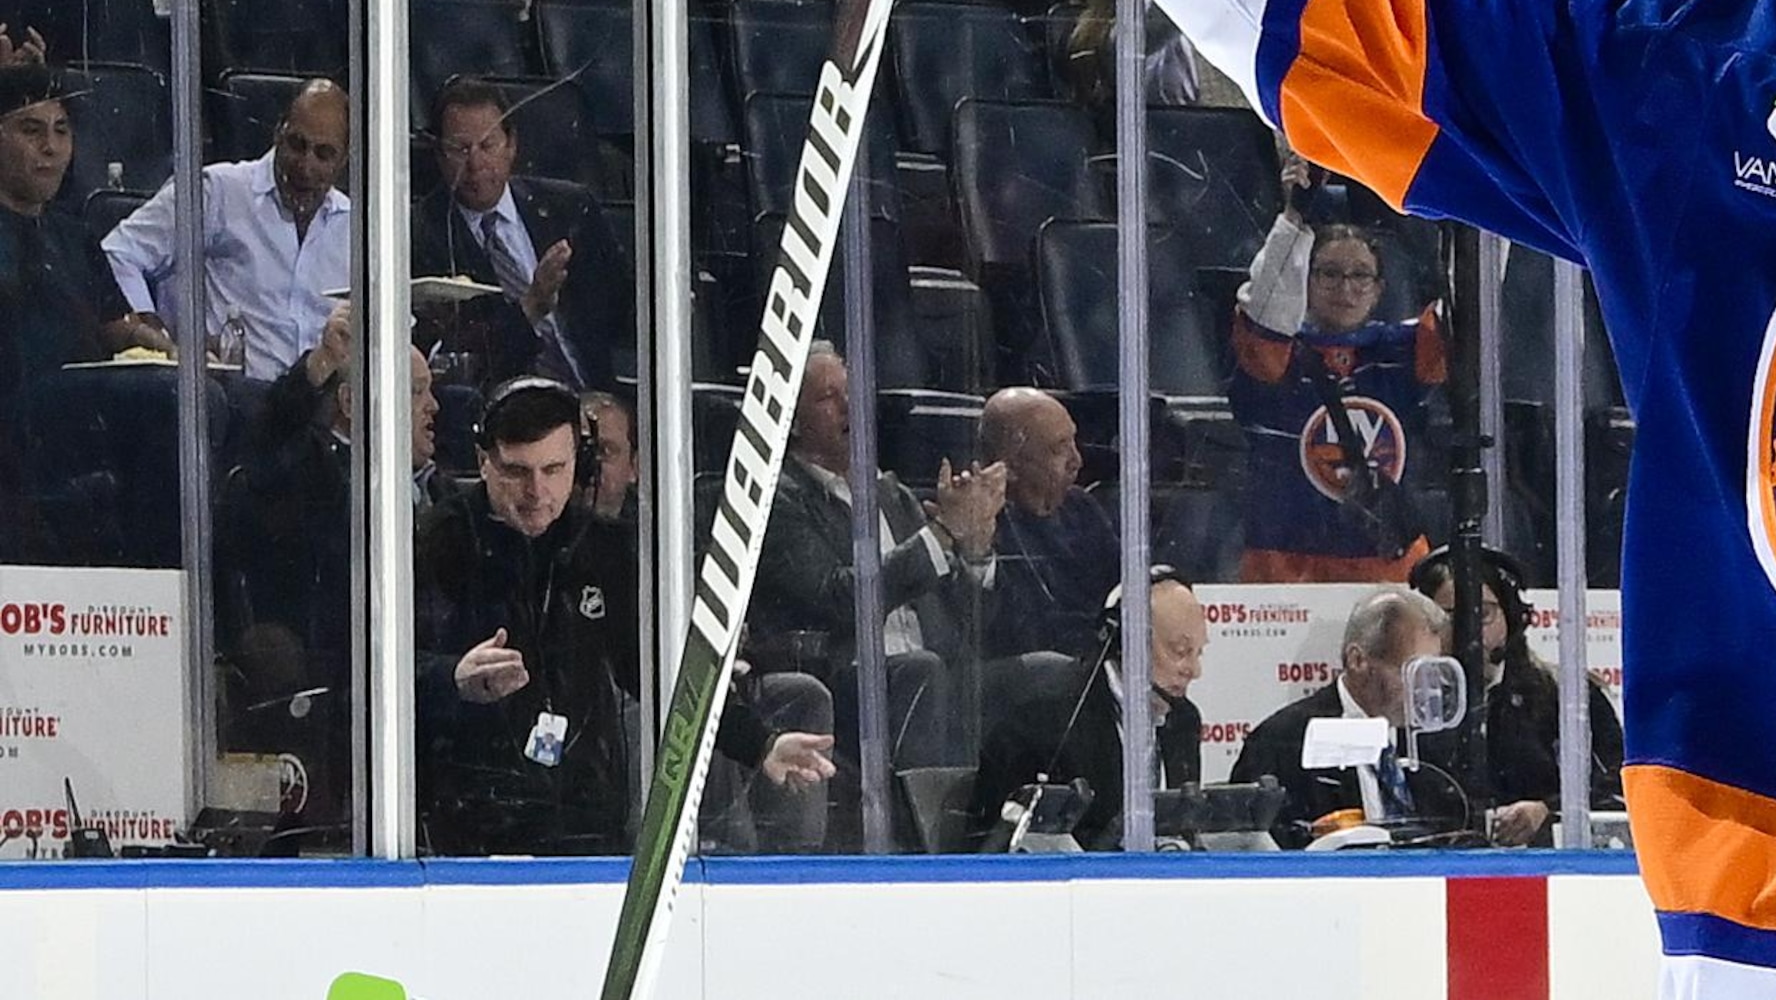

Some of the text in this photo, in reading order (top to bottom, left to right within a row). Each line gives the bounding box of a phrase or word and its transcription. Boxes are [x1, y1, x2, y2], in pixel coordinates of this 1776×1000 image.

[692, 59, 854, 657] WARRIOR
[0, 603, 66, 635] OB'S
[71, 613, 169, 636] FURNITURE
[24, 644, 132, 657] MYBOBS.COM
[1278, 663, 1328, 682] BOB'S
[0, 716, 57, 737] ITURE
[0, 809, 69, 839] OB'S
